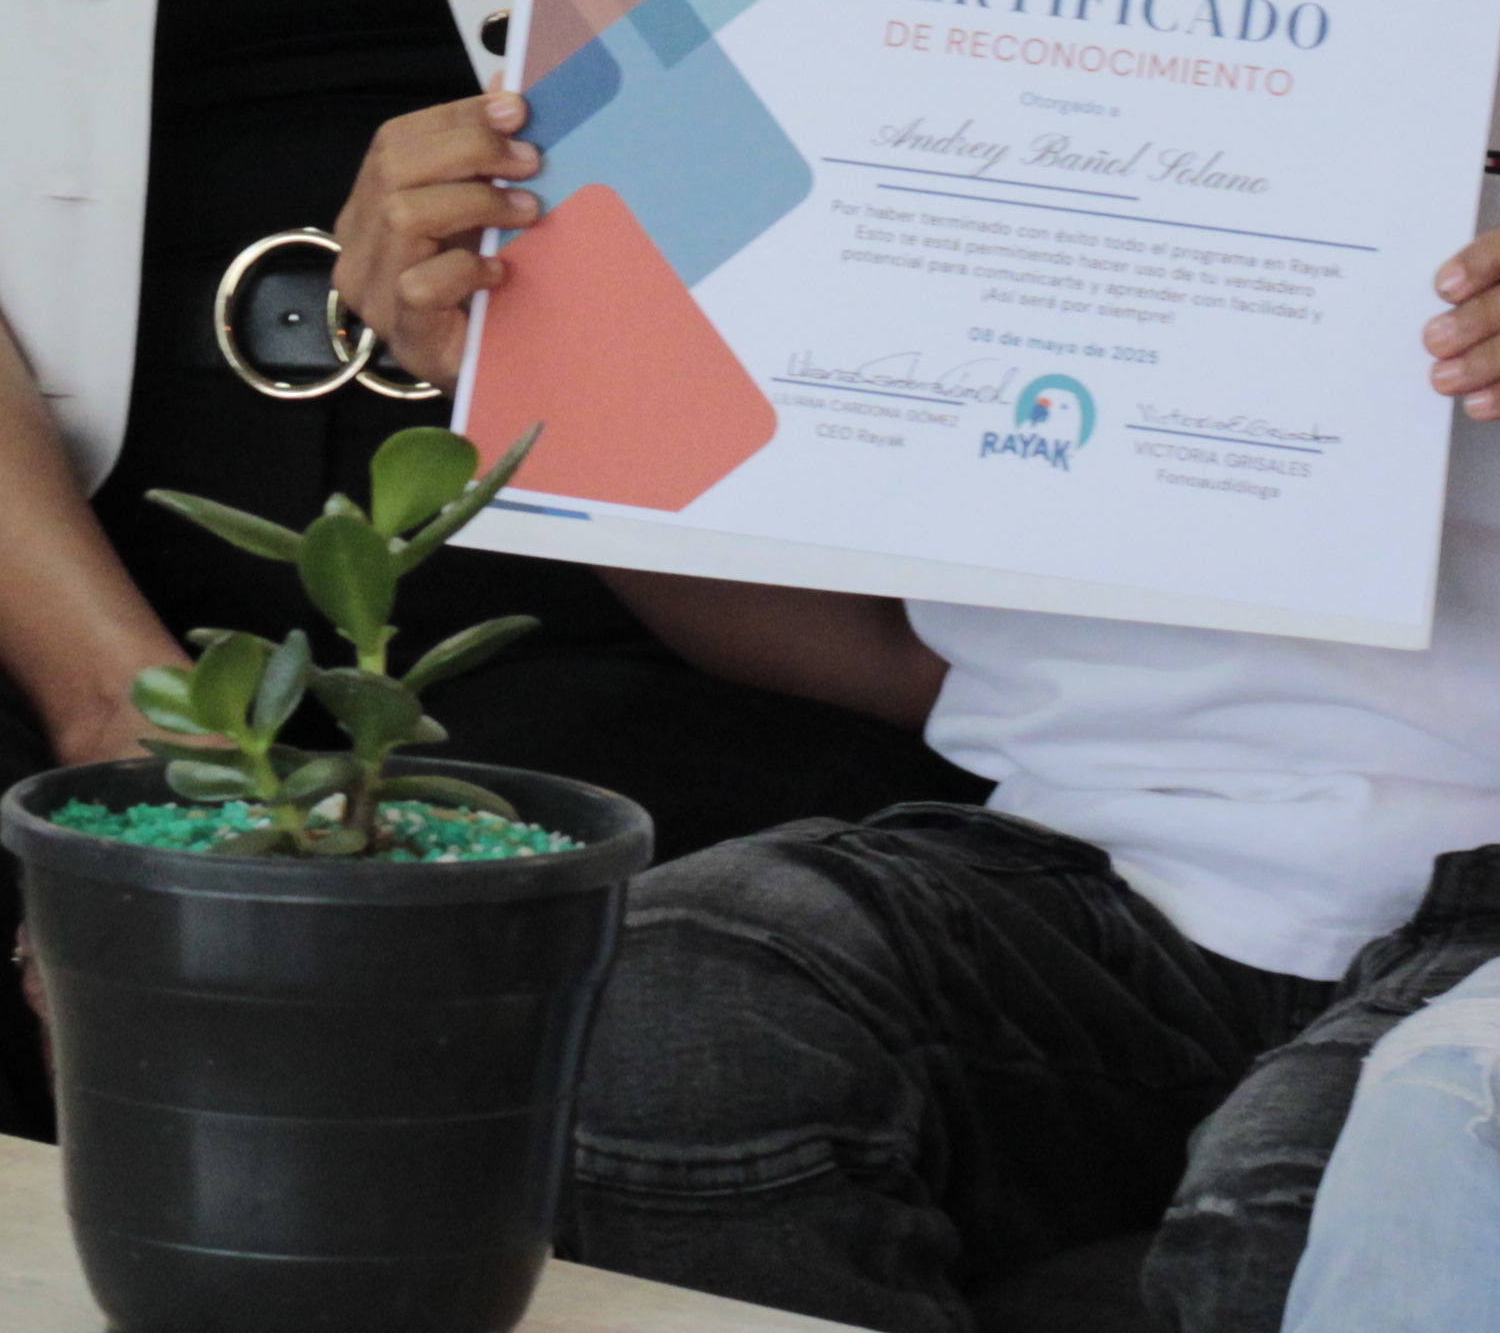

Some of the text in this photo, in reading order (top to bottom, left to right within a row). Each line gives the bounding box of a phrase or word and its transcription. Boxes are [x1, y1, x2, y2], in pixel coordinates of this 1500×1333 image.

[883, 20, 1295, 96] DE RECONOCIMIENTO
[1019, 90, 1121, 118] Otorgado a
[870, 117, 1011, 178] Andrey
[1148, 148, 1273, 196] Solano
[830, 199, 860, 216] Por
[865, 204, 917, 223] haber
[920, 213, 1012, 235] terminado
[1016, 226, 1050, 239] con
[1103, 235, 1147, 253] todo
[1152, 242, 1168, 256] el
[1171, 245, 1258, 267] programa
[1262, 257, 1286, 270] en
[855, 224, 896, 243] Esto
[900, 232, 919, 246] te
[1079, 254, 1129, 273] hacer
[1133, 264, 1168, 278] uso
[1171, 266, 1195, 282] de
[1200, 271, 1219, 285] tu
[1223, 275, 1316, 297] verdadero
[840, 248, 925, 269] potencial
[927, 259, 969, 275] para
[972, 264, 1085, 290] comunicarte
[1104, 281, 1187, 303] aprender
[1191, 293, 1227, 309] con
[1230, 295, 1309, 320] facilidad
[1060, 299, 1091, 314] por
[999, 331, 1023, 347] de
[1025, 337, 1079, 355] mayo
[1082, 341, 1107, 358] de
[1111, 344, 1160, 365] 2025
[815, 422, 906, 450] CEO Rayak
[979, 430, 1074, 473] RAYAK
[1132, 439, 1313, 479] VICTORIA GRISALES
